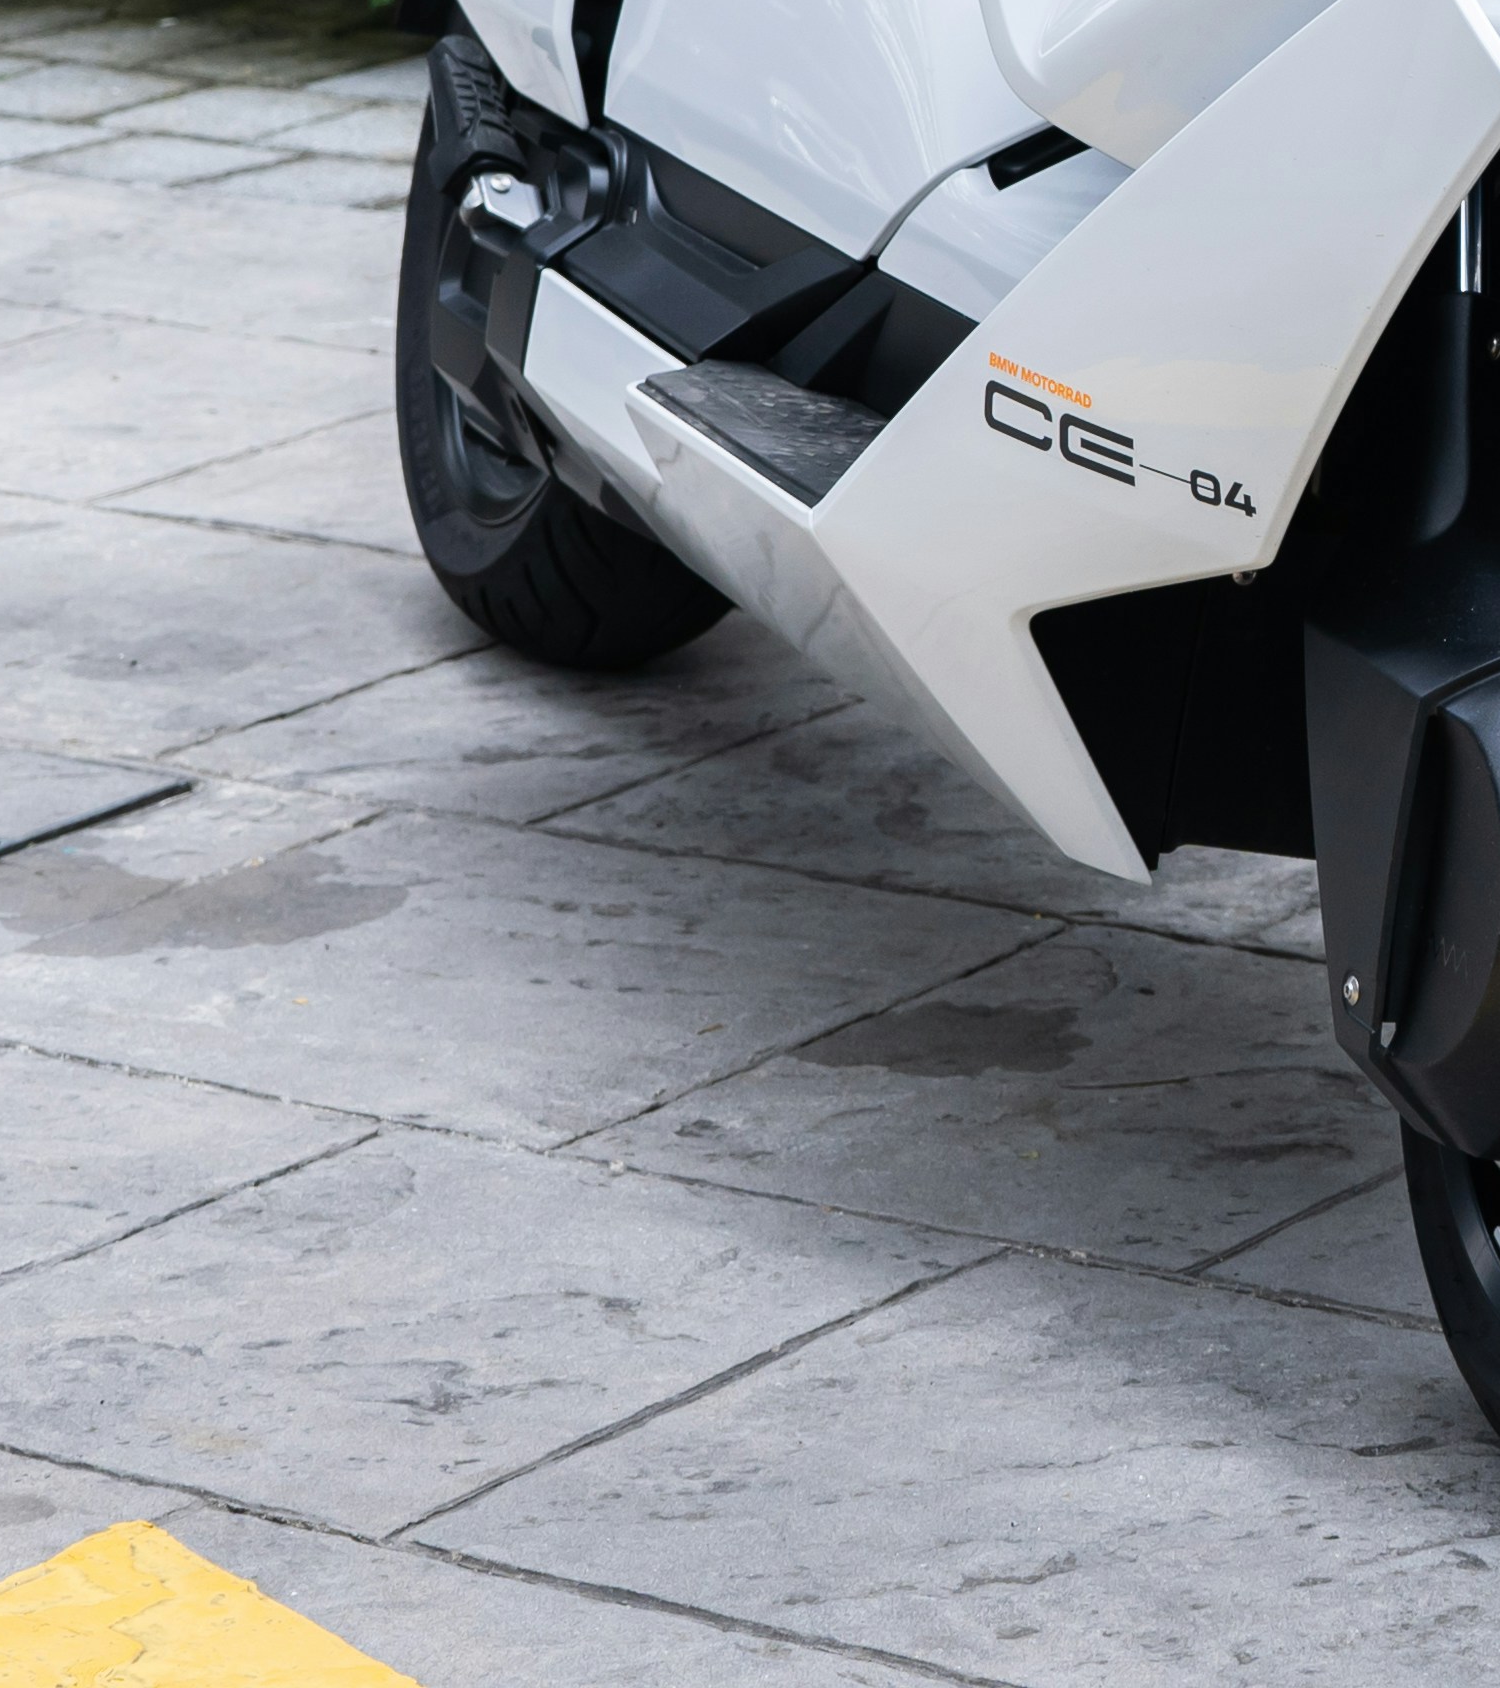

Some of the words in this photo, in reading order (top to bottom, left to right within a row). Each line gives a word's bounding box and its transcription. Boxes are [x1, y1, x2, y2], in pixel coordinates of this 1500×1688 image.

[989, 351, 1018, 377] BMW
[1020, 366, 1092, 409] MOTORRAD
[984, 379, 1135, 487] CE
